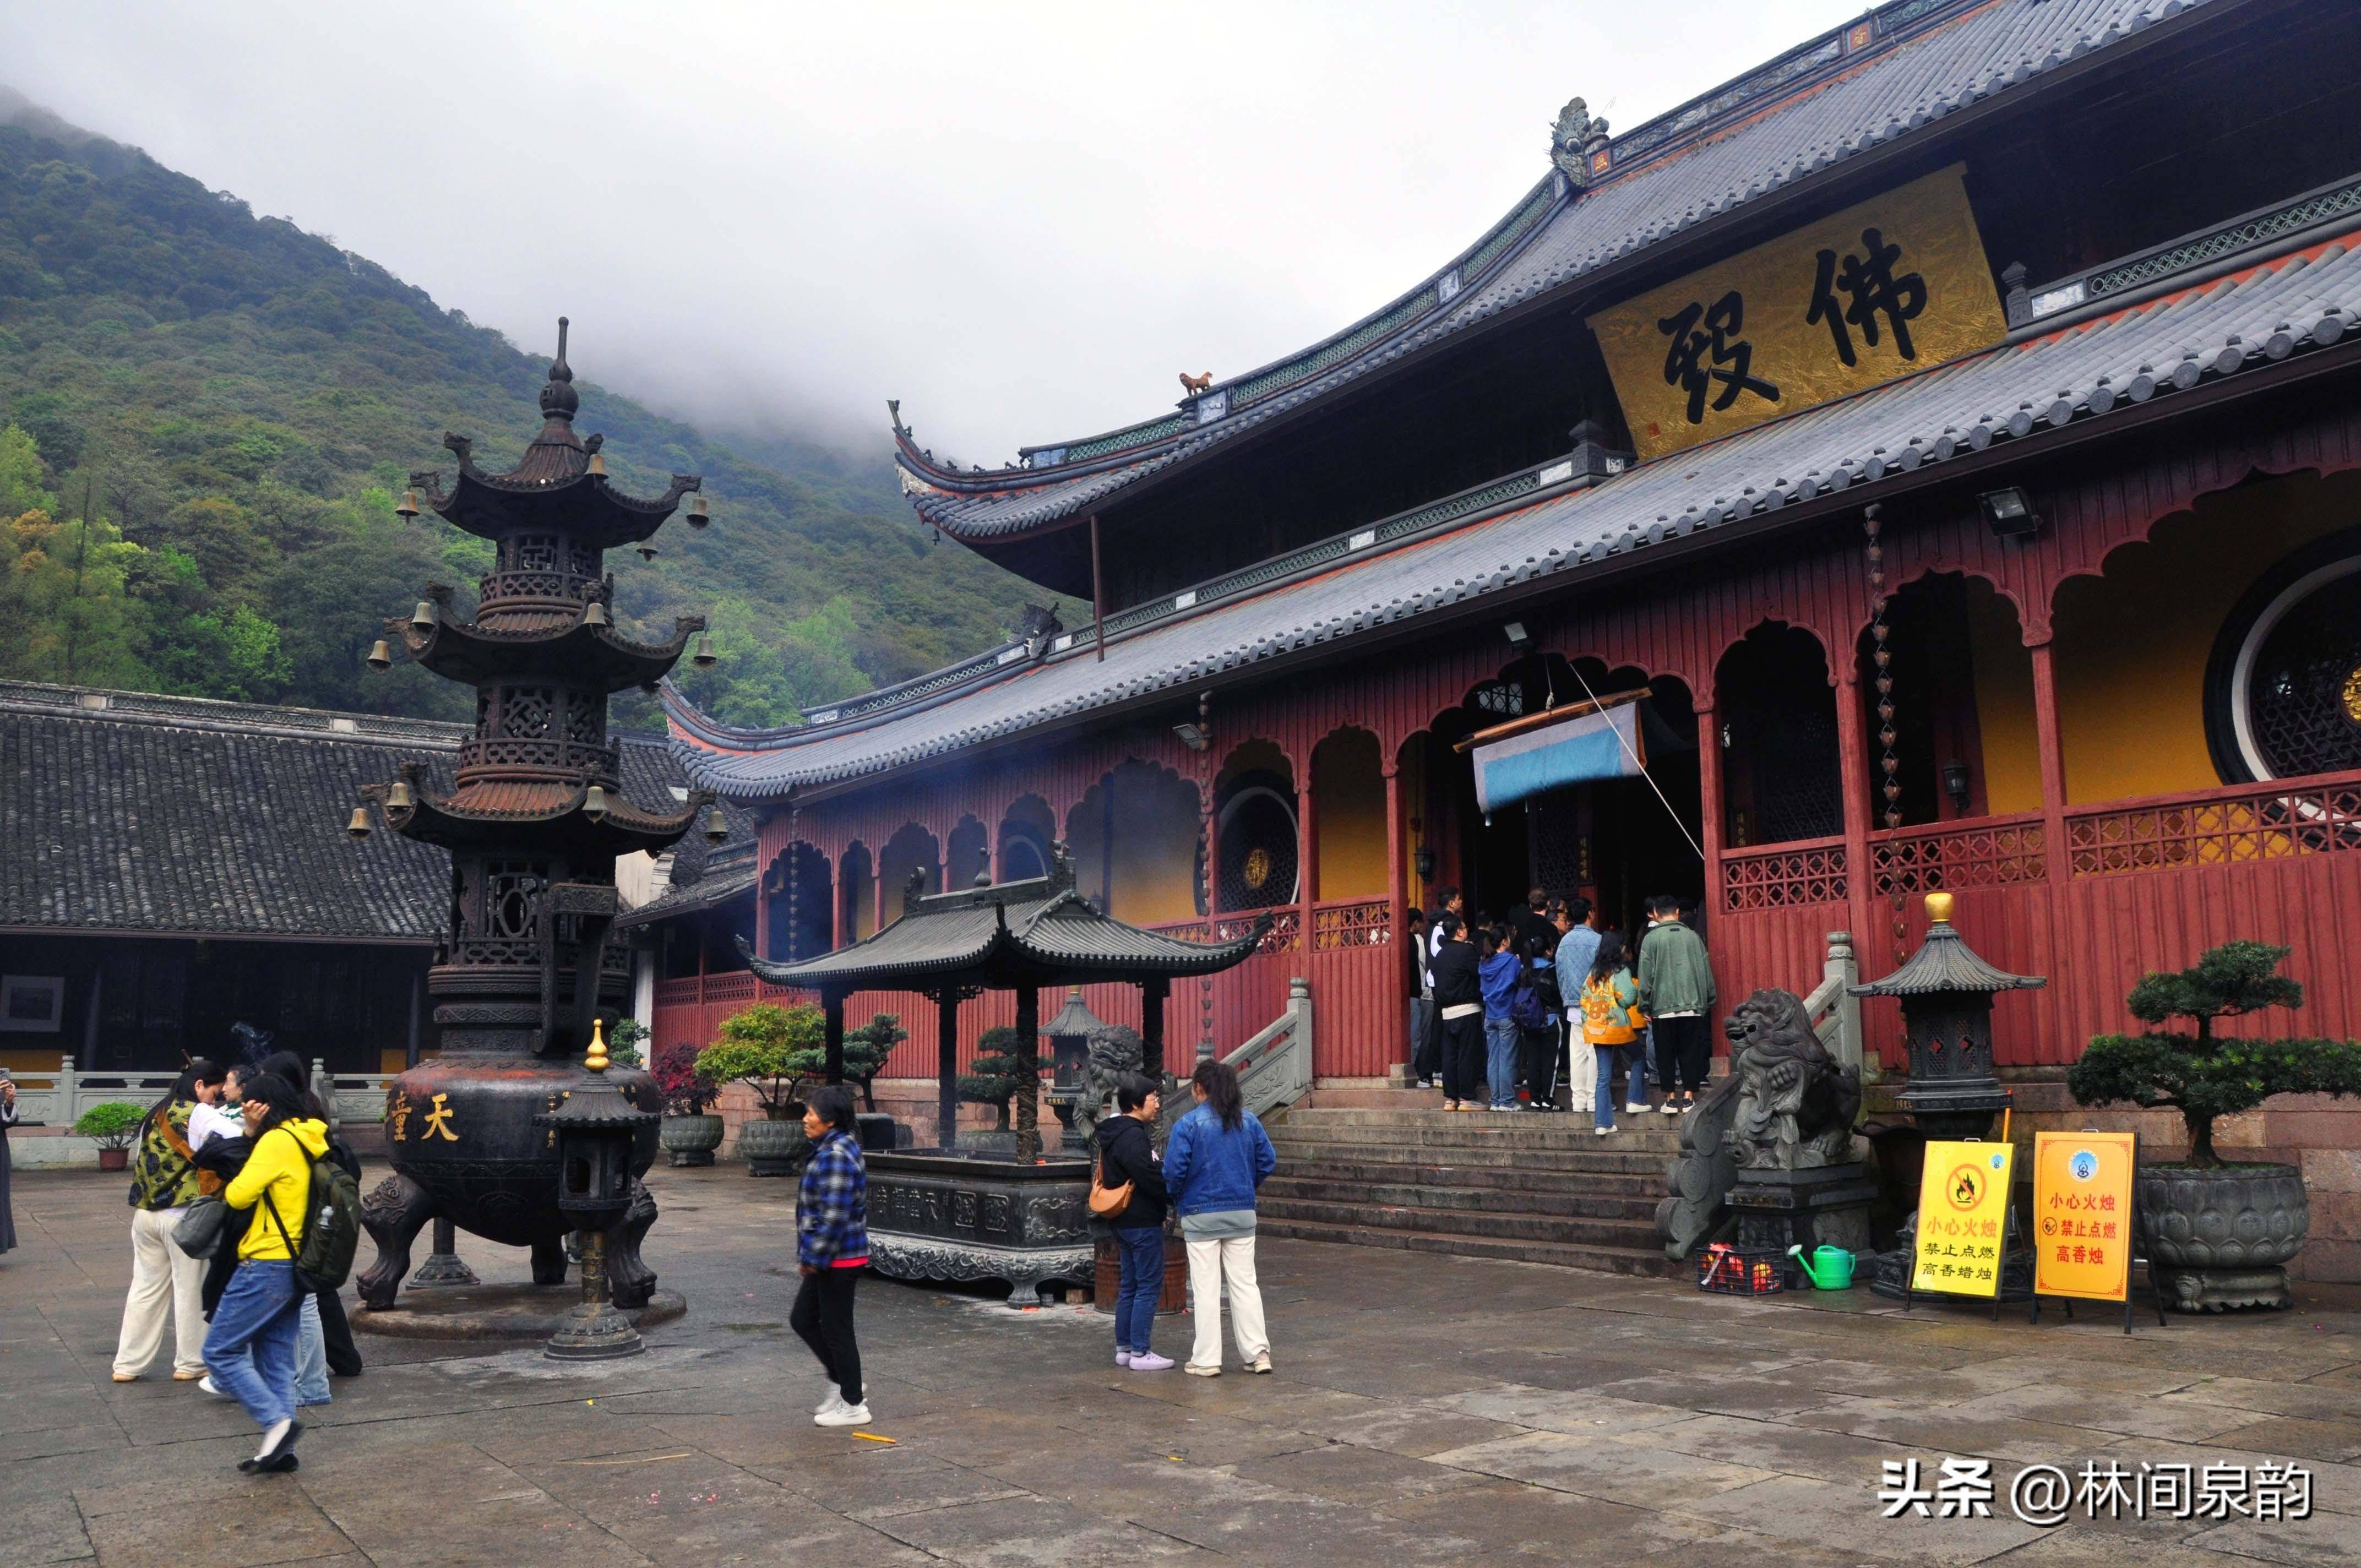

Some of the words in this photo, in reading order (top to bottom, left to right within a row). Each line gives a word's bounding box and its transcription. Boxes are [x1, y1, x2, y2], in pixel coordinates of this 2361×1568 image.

[2050, 1192, 2115, 1211] 小心火烛
[1927, 1215, 1997, 1238] 小心火烛
[2061, 1219, 2117, 1239] 禁止点燃
[1924, 1242, 1995, 1260] 禁止点燃
[2056, 1244, 2103, 1265] 高香烛
[1922, 1262, 1992, 1281] 高香蜡烛
